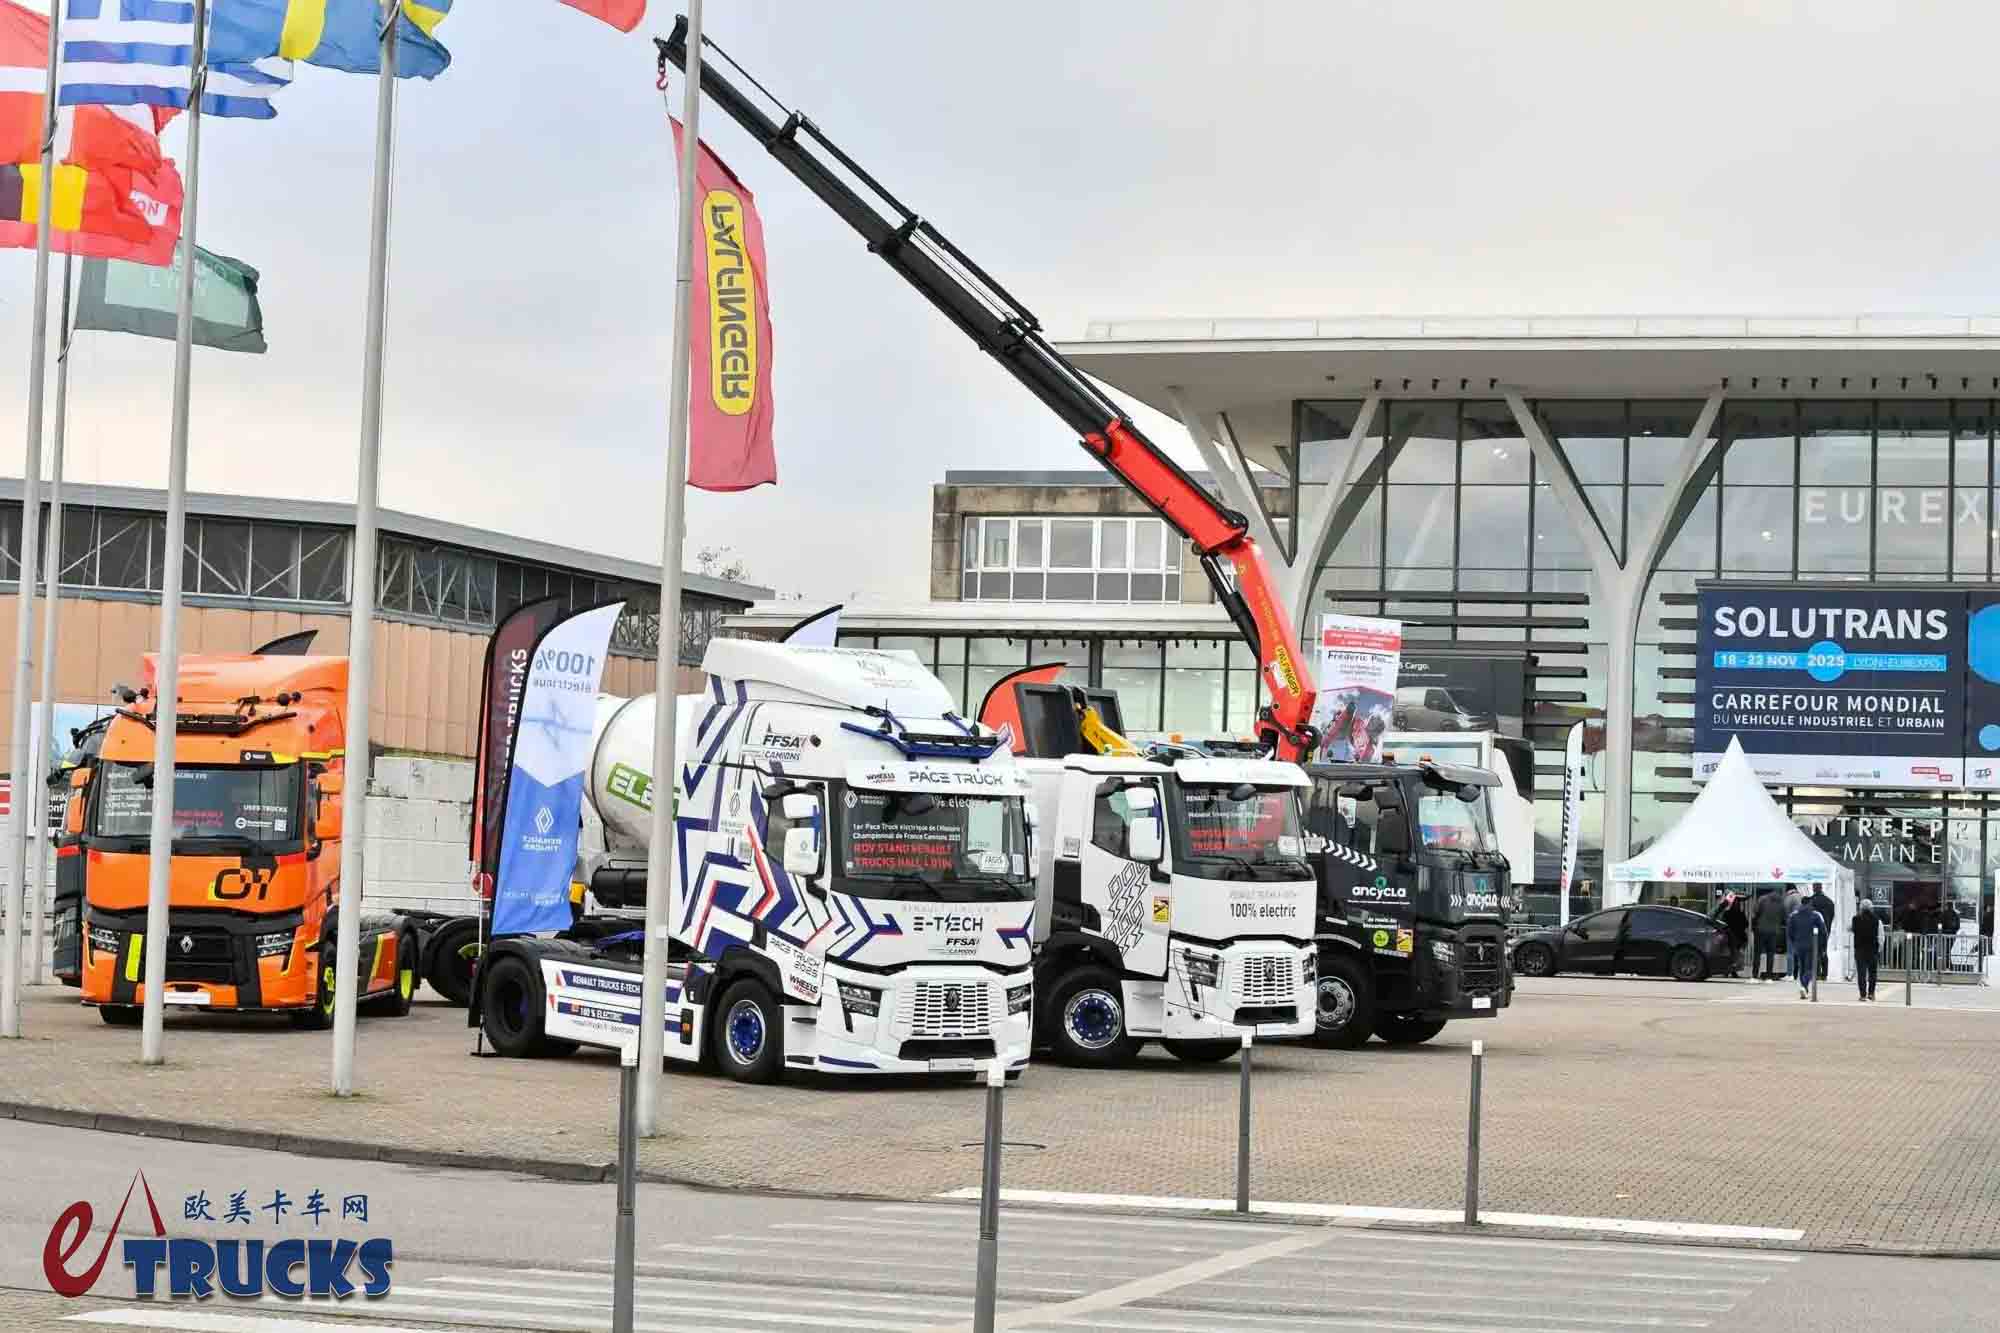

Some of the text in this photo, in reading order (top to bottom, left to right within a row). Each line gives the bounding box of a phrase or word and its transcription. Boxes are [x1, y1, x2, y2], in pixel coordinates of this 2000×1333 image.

[1713, 606, 1948, 640] SOLUTRANS
[1721, 655, 1737, 666] 18
[1767, 655, 1797, 666] NOV
[1808, 656, 1845, 667] 2025
[1712, 693, 1944, 713] CARREFOUR MONDIAL
[1713, 714, 1944, 729] DU VEHICULE INDUSTRIEL ET URBAIN
[762, 734, 801, 748] FFSA
[908, 771, 950, 784] PACE
[952, 773, 1004, 786] TRUCK
[1843, 842, 1916, 863] MAIN
[1230, 903, 1297, 918] 100% electric
[946, 938, 977, 946] FFSA
[597, 978, 620, 991] TRUCKS
[789, 973, 819, 994] WHEELS
